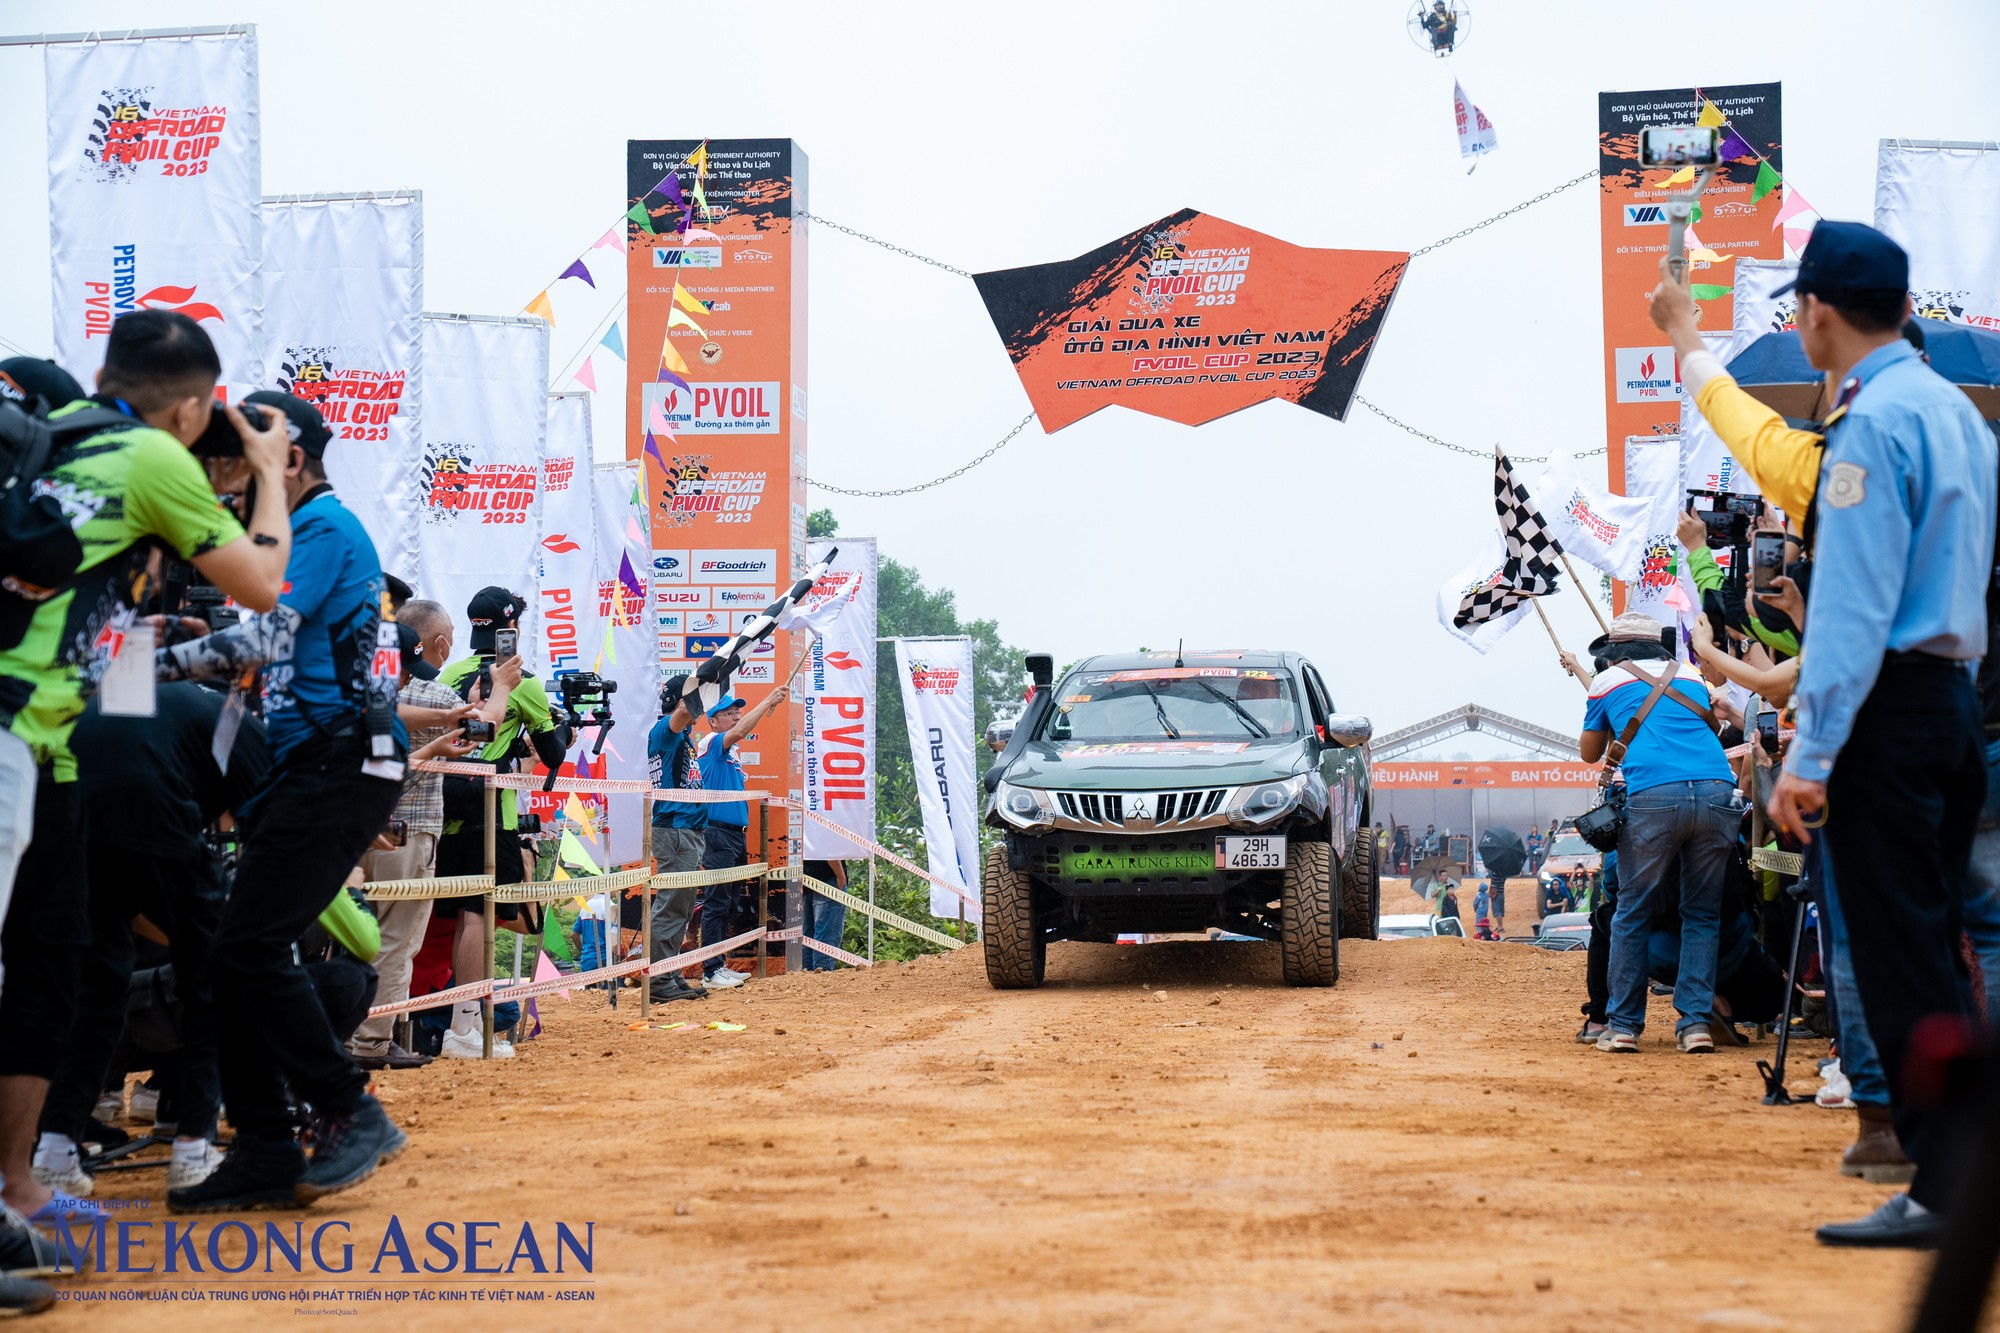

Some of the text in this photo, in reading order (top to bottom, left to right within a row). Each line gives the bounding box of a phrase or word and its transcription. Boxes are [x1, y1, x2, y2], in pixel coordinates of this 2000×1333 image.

[1636, 103, 1652, 112] CHỦ
[1725, 96, 1765, 106] AUTHORITY
[114, 106, 139, 120] 16
[153, 106, 226, 118] VIETNAM
[1622, 114, 1634, 123] Bộ
[1636, 113, 1651, 122] Văn
[1736, 107, 1754, 117] Lịch
[108, 116, 226, 140] OFFROAD
[102, 136, 220, 164] PVOIL CUP
[161, 160, 208, 176] 2023
[653, 162, 662, 170] Bộ
[755, 160, 770, 170] Lịch
[1155, 246, 1174, 258] 16
[1188, 247, 1250, 258] VIETNAM
[1616, 246, 1628, 254] ĐỐI
[1630, 245, 1642, 253] TÁC
[1728, 240, 1760, 248] PARTNER
[1150, 256, 1250, 276] OFFROAD
[1145, 274, 1245, 296] PVOIL CUP
[1195, 294, 1236, 306] 2023
[85, 281, 110, 339] PVOIL
[1067, 315, 1202, 333] GIẢI ĐUA XE
[1063, 328, 1326, 356] ÔTÔ ĐỊA HÌNH VIỆT NAM
[1132, 350, 1320, 372] PVOIL CUP 2023
[298, 366, 324, 380] 16
[334, 370, 406, 380] VIETNAM
[1056, 370, 1318, 390] VIETNAM OFFROAD PVOIL CUP 2023
[292, 380, 404, 400] OFFROAD
[1627, 380, 1670, 388] PETROVIETNAM
[1640, 388, 1658, 396] PVOIL
[694, 388, 770, 418] PVOIL
[352, 402, 398, 425] CUP
[695, 420, 722, 430] Đường
[756, 420, 770, 430] gần
[340, 426, 388, 441] 2023
[437, 458, 459, 471] 16
[474, 464, 537, 474] VIETNAM
[433, 471, 536, 490] OFFROAD
[548, 472, 572, 485] CUP
[680, 468, 698, 480] 16
[544, 482, 568, 492] 2023
[677, 480, 765, 494] OFFROAD
[430, 491, 534, 510] PVOIL CUP
[672, 495, 760, 512] PVOIL CUP
[482, 512, 526, 524] 2023
[715, 512, 752, 524] 2023
[1593, 531, 1612, 546] 2023
[1597, 526, 1618, 540] CUP
[1651, 546, 1668, 556] 16
[701, 561, 766, 570] BFGoodrich
[542, 588, 578, 662] PVOIL
[913, 672, 959, 680] OFFROAD
[938, 680, 958, 688] CUP
[805, 697, 822, 811] Đường xa thêm gần
[820, 696, 866, 810] PVOIL
[1400, 769, 1438, 782] HÀNH
[1512, 770, 1538, 782] BAN
[1542, 767, 1560, 782] TỔ
[1242, 839, 1268, 852] 29H
[1075, 854, 1210, 870] GARA TRUNG KIÊN
[1232, 854, 1280, 868] 486.33
